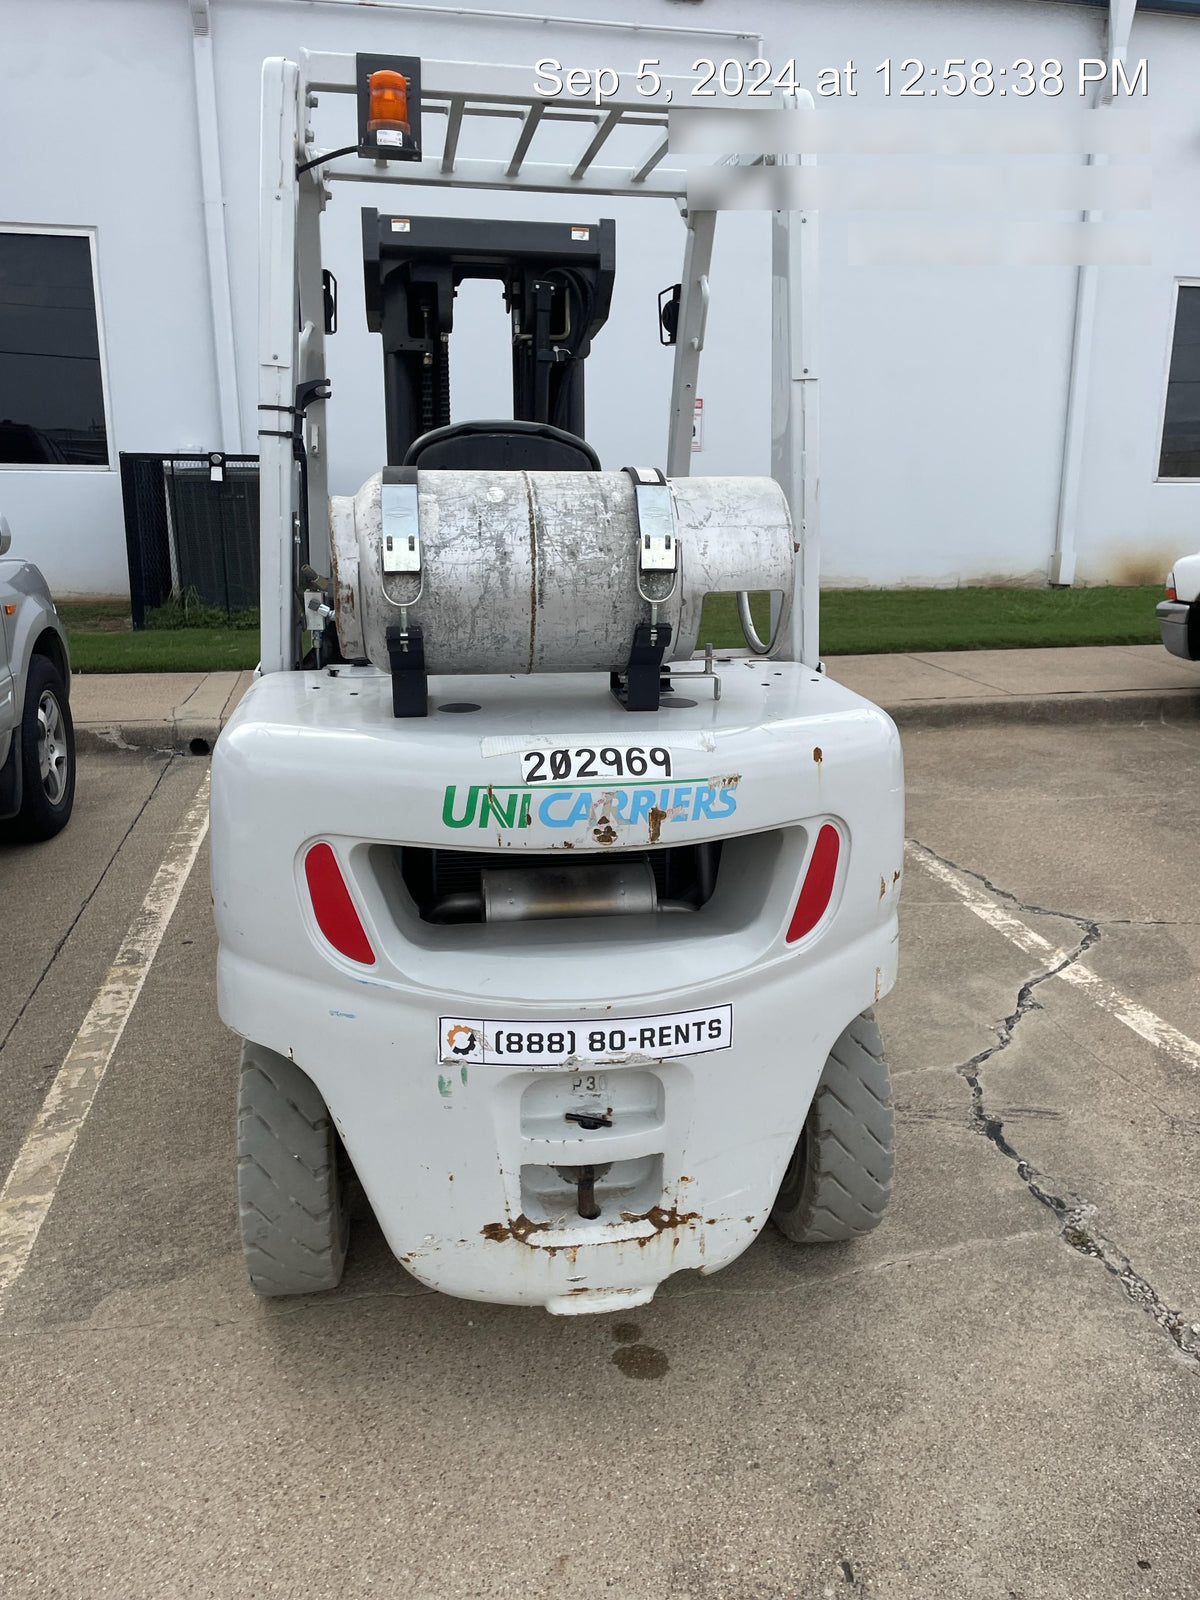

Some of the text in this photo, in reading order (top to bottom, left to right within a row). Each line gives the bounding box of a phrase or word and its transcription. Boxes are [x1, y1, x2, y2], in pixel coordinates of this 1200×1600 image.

[523, 747, 672, 782] 202969
[495, 1018, 722, 1055] (888) 80-RENTS
